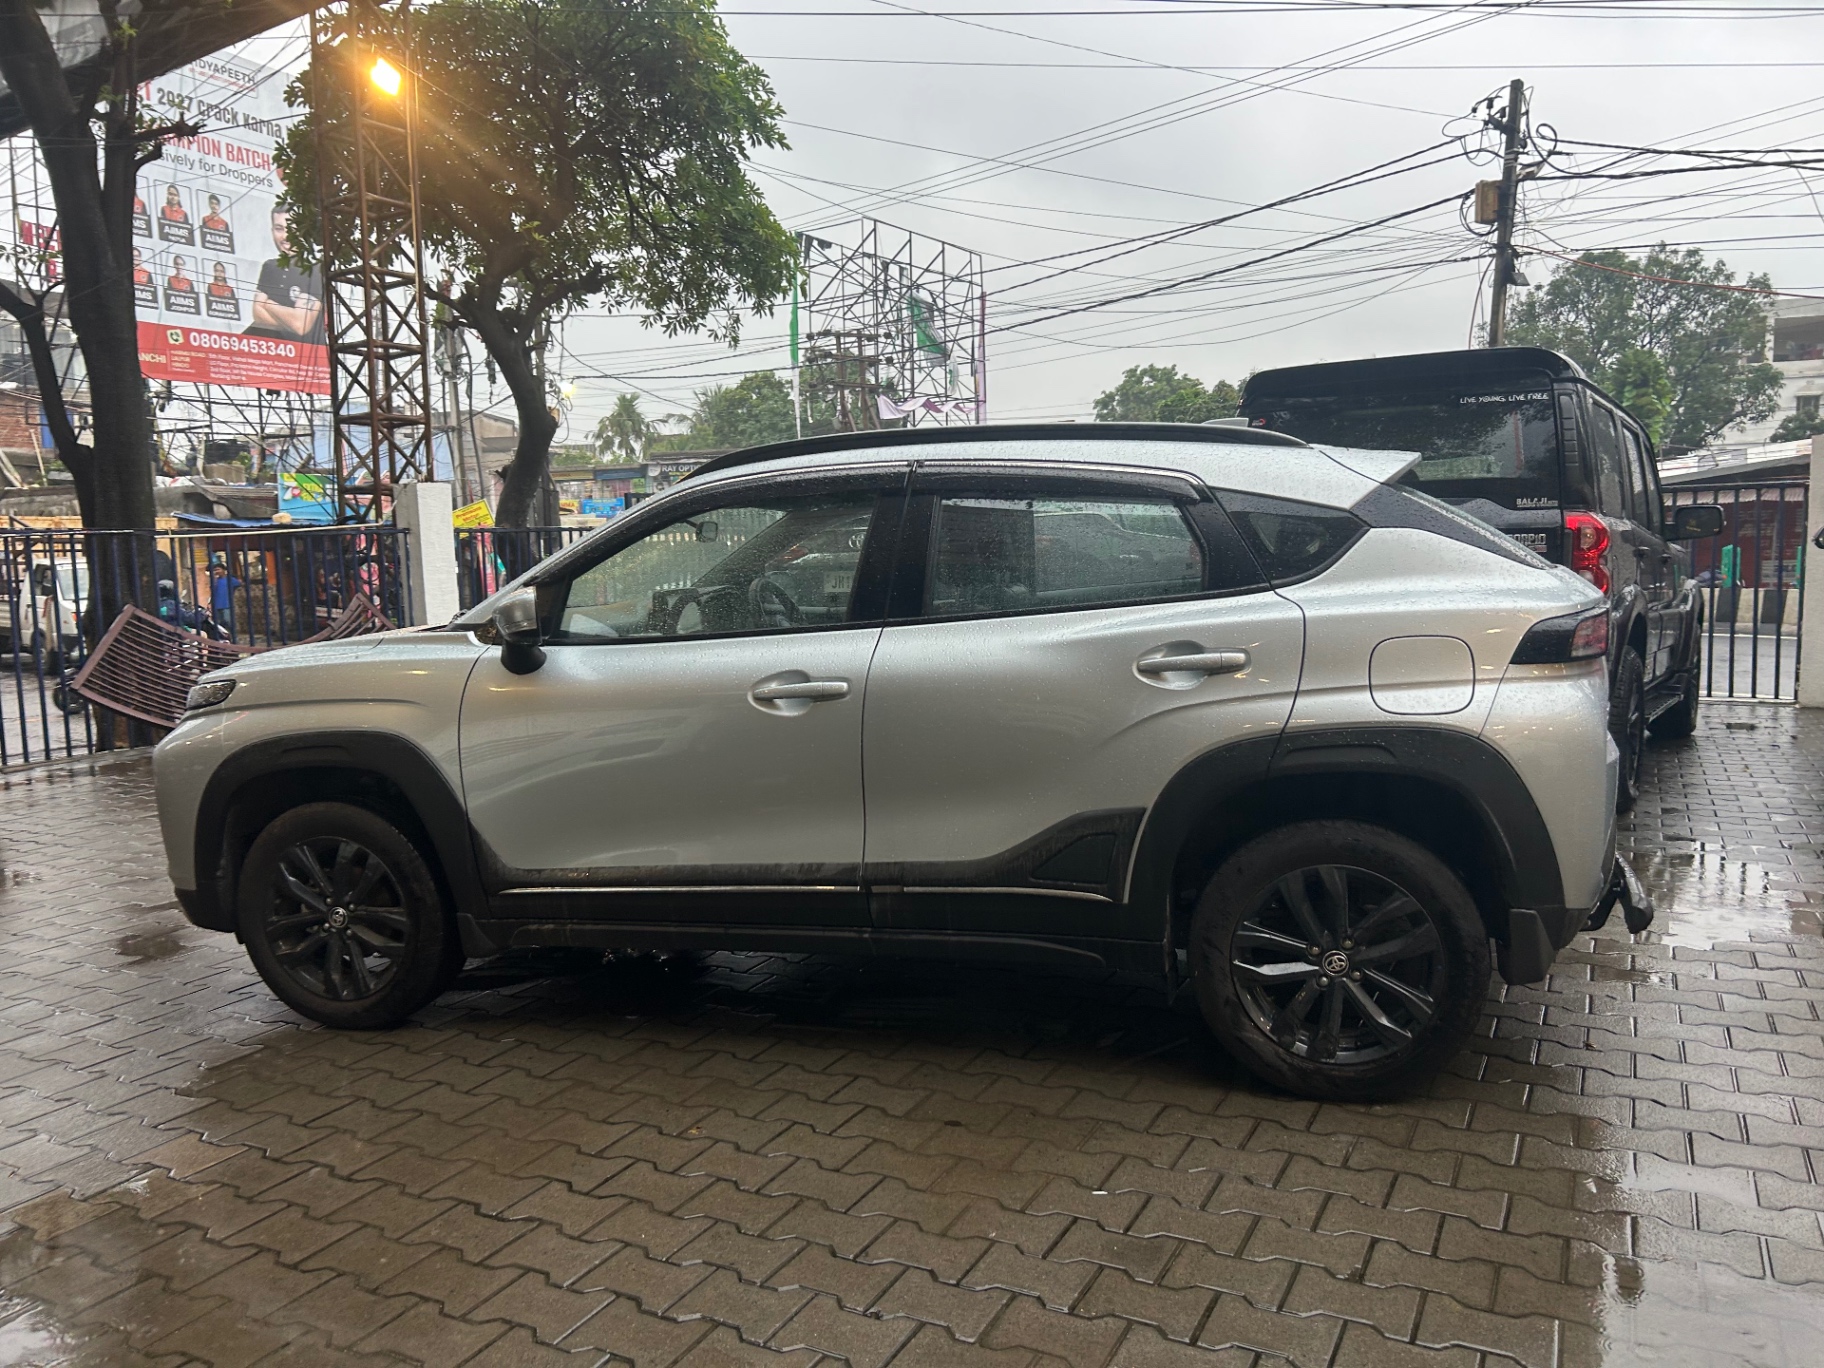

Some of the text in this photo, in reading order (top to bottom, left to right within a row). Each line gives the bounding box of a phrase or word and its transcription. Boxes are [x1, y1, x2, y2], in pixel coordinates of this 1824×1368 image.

[225, 142, 271, 172] BATCH
[199, 158, 216, 173] for
[219, 163, 274, 188] Droppers
[164, 225, 190, 238] AIIMS
[205, 233, 230, 245] AIIMS
[169, 295, 195, 307] AIIMS
[211, 302, 236, 313] AIIMS
[189, 331, 296, 358] 08069453340
[1460, 396, 1477, 404] LIVE
[1509, 394, 1526, 402] LIVE
[662, 464, 678, 472] RAY
